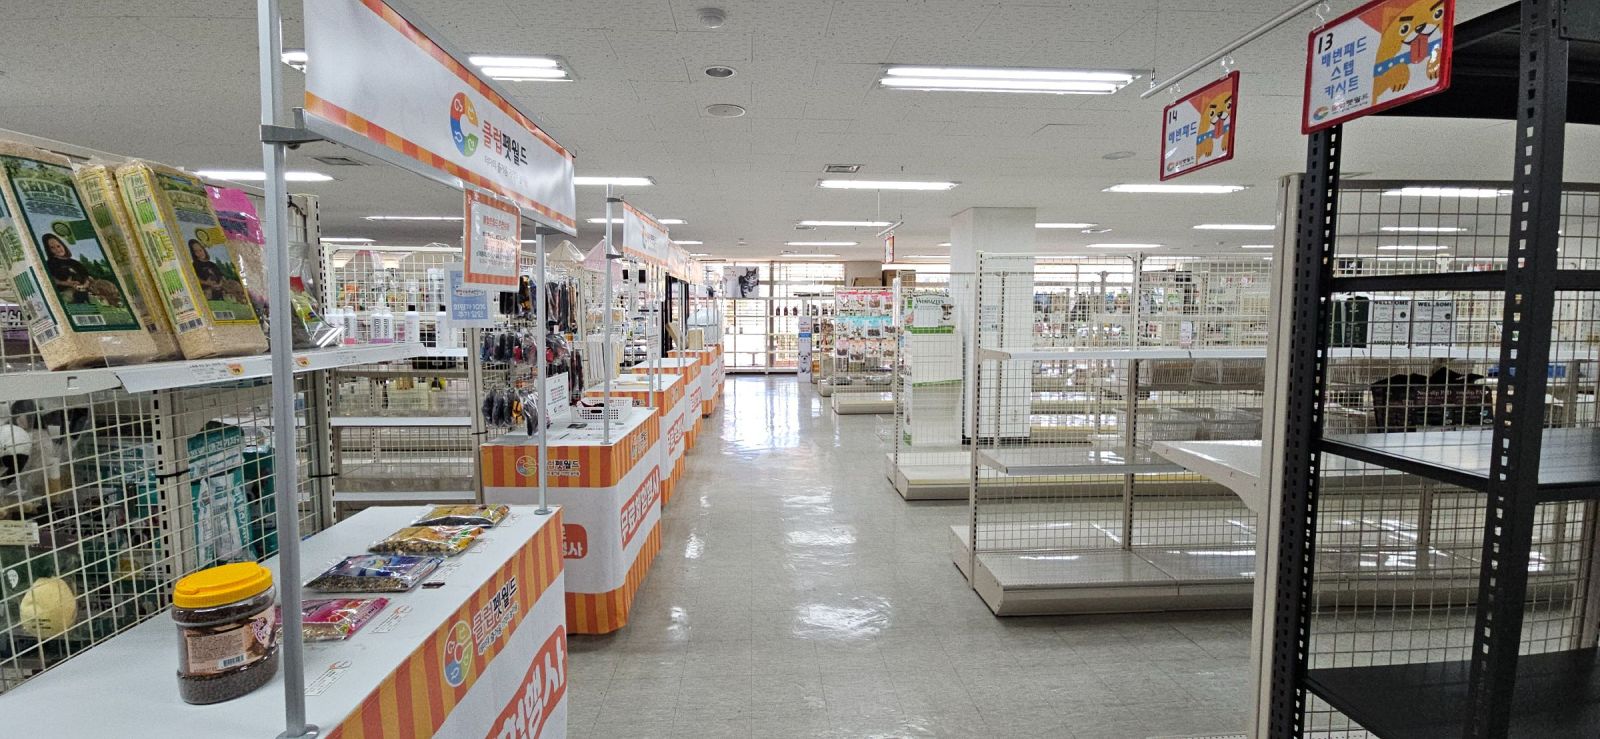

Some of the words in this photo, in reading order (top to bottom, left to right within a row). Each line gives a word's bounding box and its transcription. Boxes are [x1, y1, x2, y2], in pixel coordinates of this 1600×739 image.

[1318, 32, 1334, 54] 13
[1321, 36, 1367, 67] 배변패드
[1324, 76, 1359, 99] 카시트
[1168, 109, 1178, 124] 14
[482, 120, 528, 166] 클럽펫월드
[1168, 121, 1198, 144] 배변패드
[473, 577, 518, 641] 클럽펫월드
